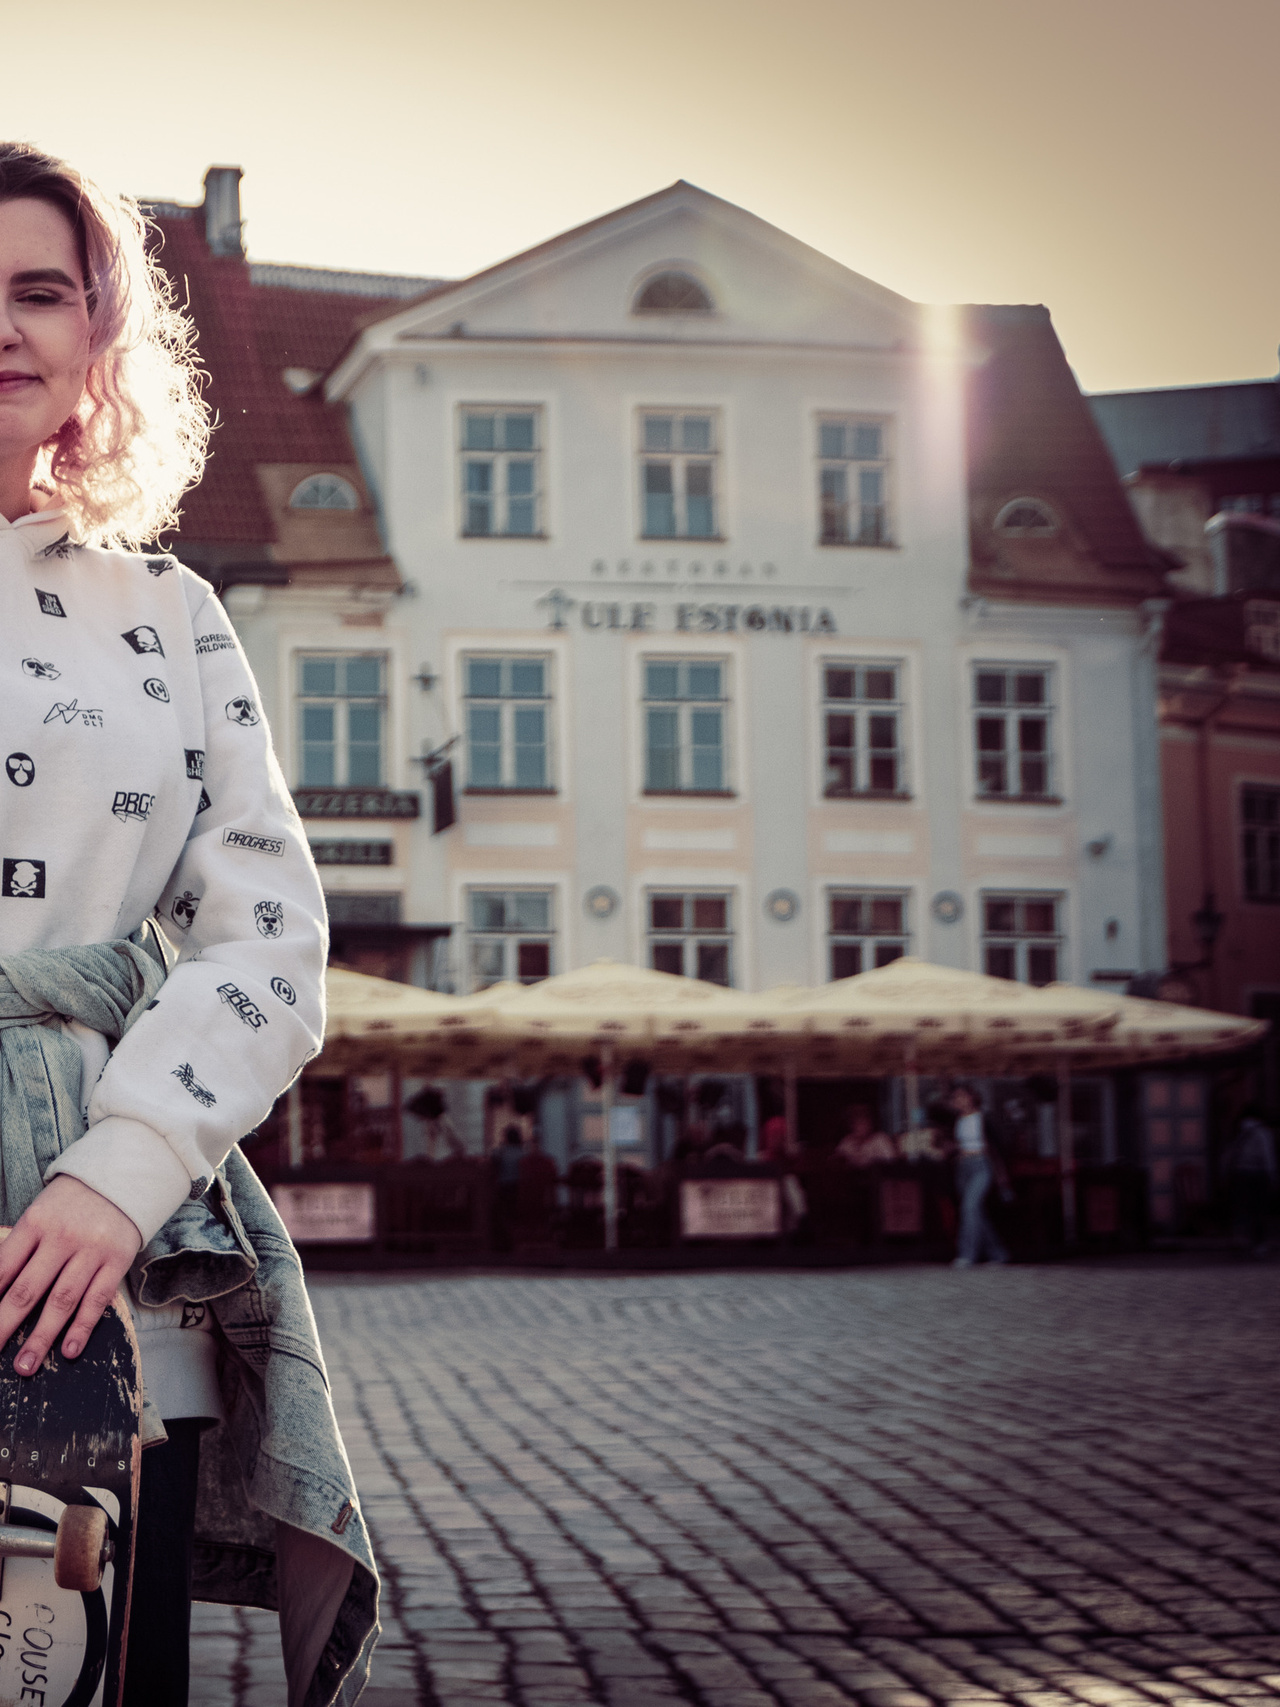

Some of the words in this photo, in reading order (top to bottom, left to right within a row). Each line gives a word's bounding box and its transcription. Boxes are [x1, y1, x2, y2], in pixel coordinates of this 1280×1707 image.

[674, 603, 838, 634] ESTONIA
[226, 831, 283, 854] PROGRESS
[254, 900, 284, 919] PRGS
[216, 982, 269, 1029] PRGS
